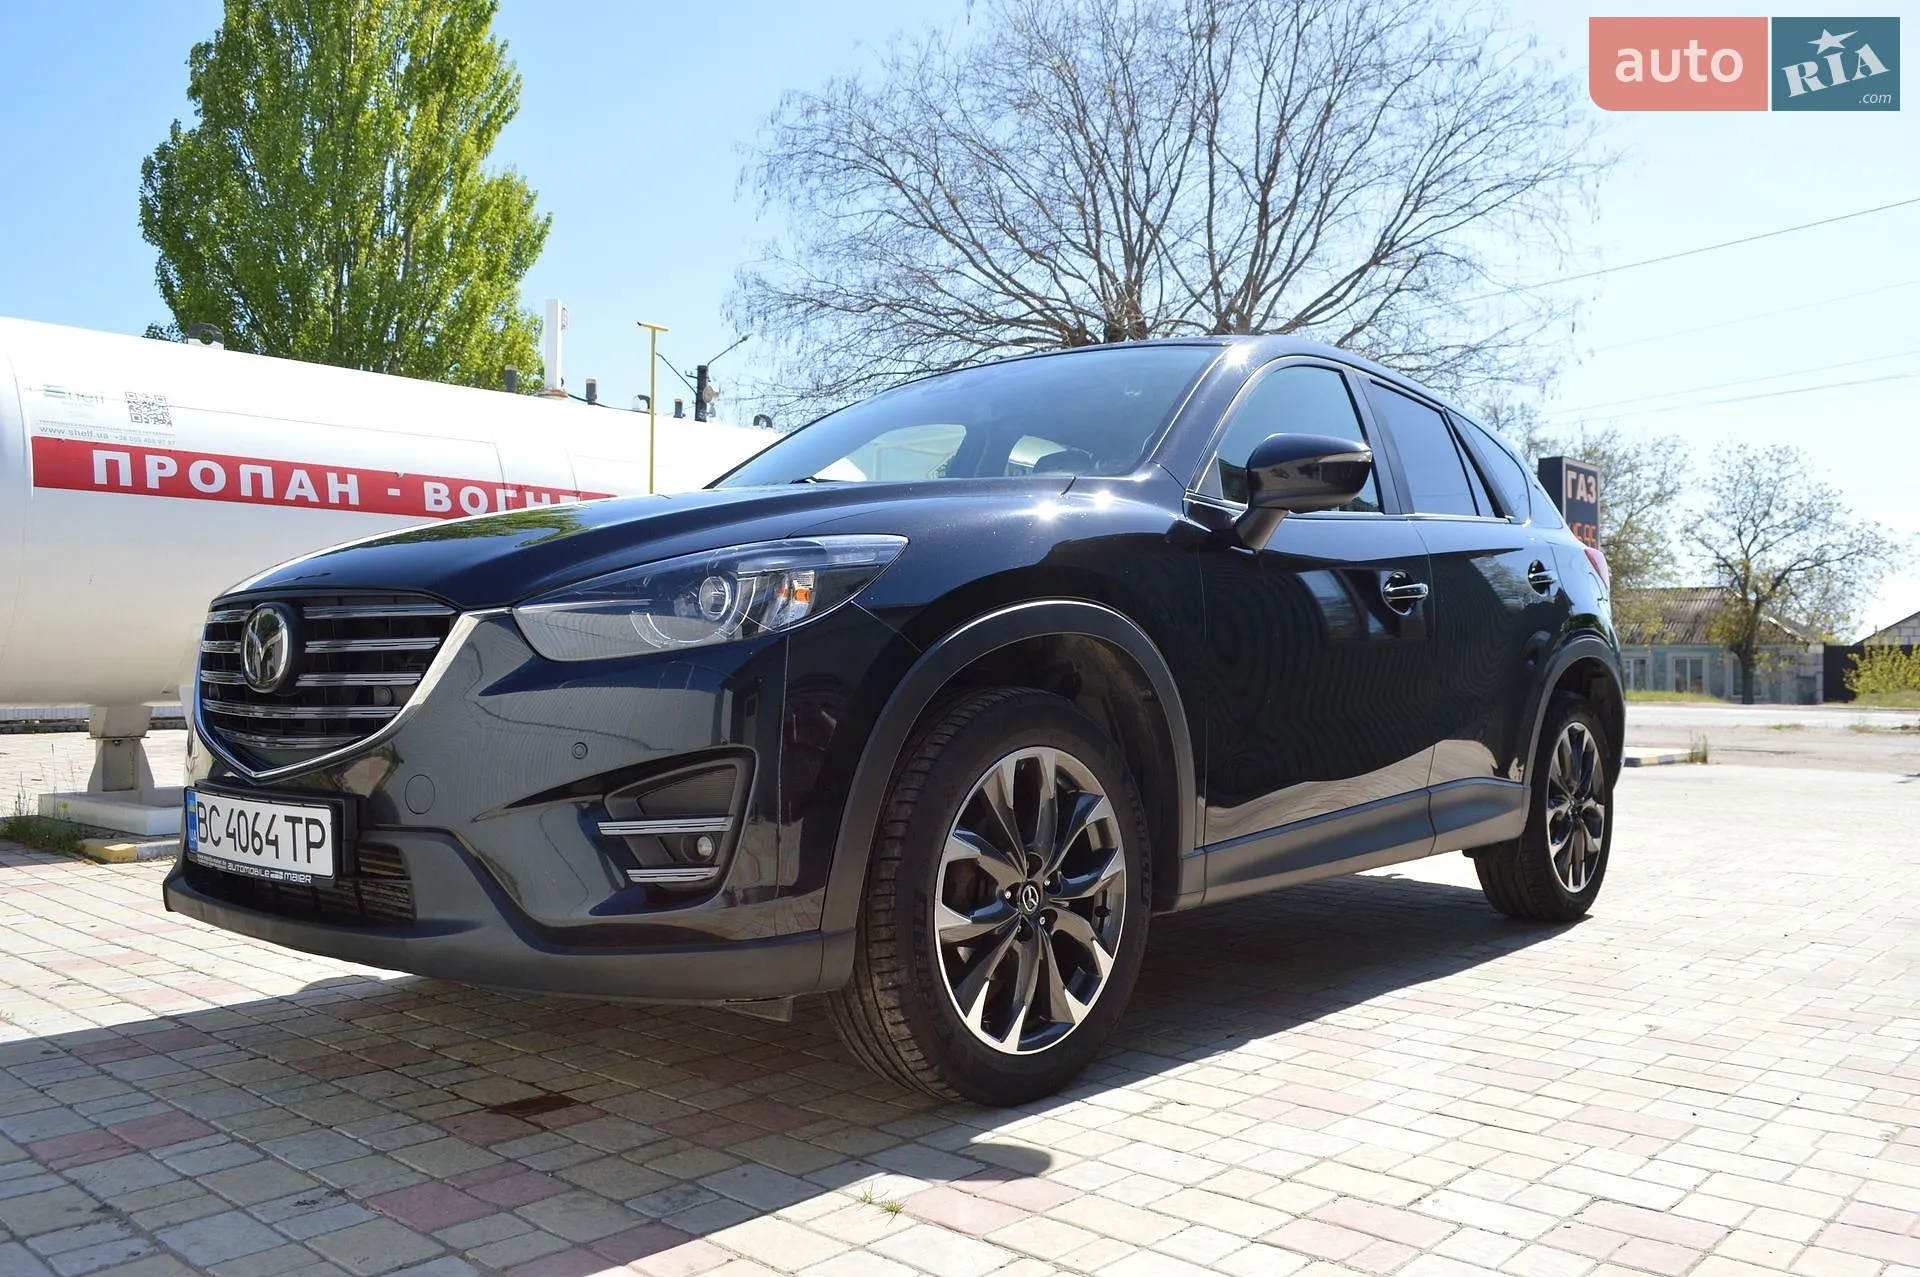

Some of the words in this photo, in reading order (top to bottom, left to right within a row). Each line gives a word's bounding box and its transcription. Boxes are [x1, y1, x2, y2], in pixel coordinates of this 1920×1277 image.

[39, 425, 109, 440] www.shelf.ua
[92, 449, 359, 506] ПРОПАН
[423, 481, 580, 515] ВОГН
[1566, 469, 1597, 505] ГАЗ
[196, 801, 222, 847] BC
[226, 807, 280, 860] 4064
[284, 814, 326, 864] TP
